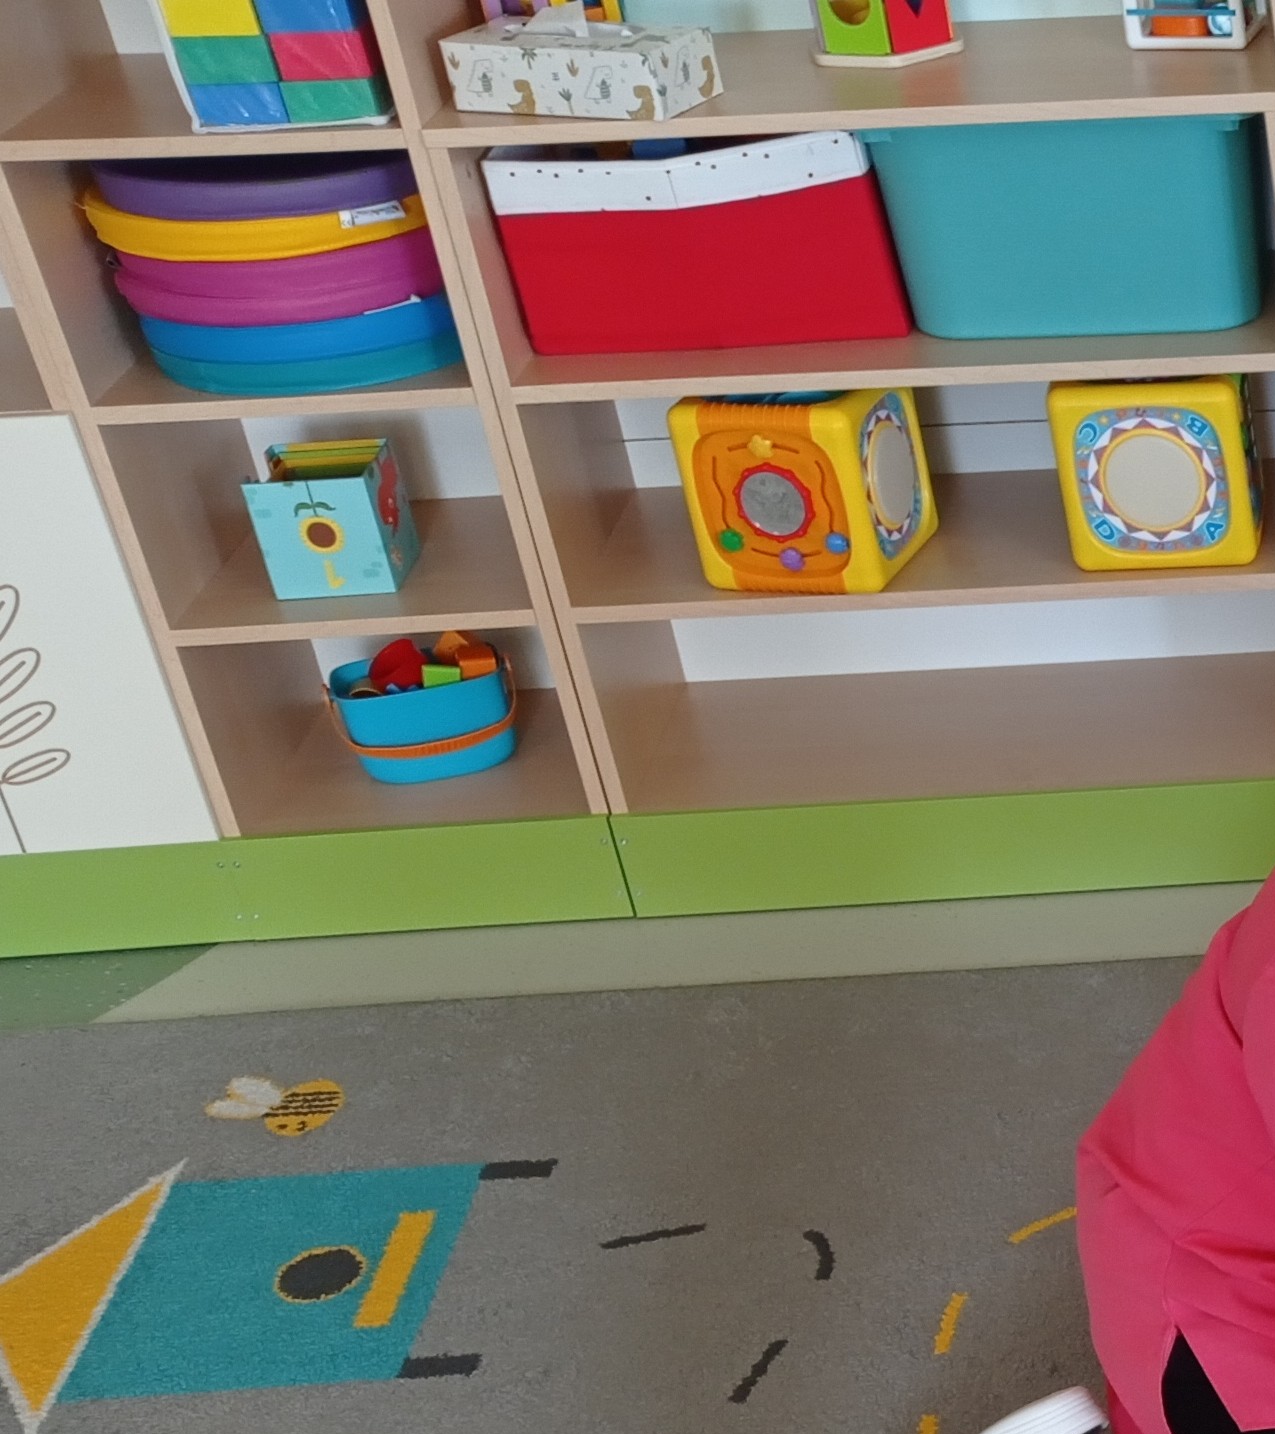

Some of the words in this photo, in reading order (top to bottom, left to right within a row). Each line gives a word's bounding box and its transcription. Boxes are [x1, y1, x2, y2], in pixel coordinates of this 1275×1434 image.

[1186, 416, 1208, 436] B
[1094, 519, 1116, 541] D
[1205, 521, 1224, 541] A
